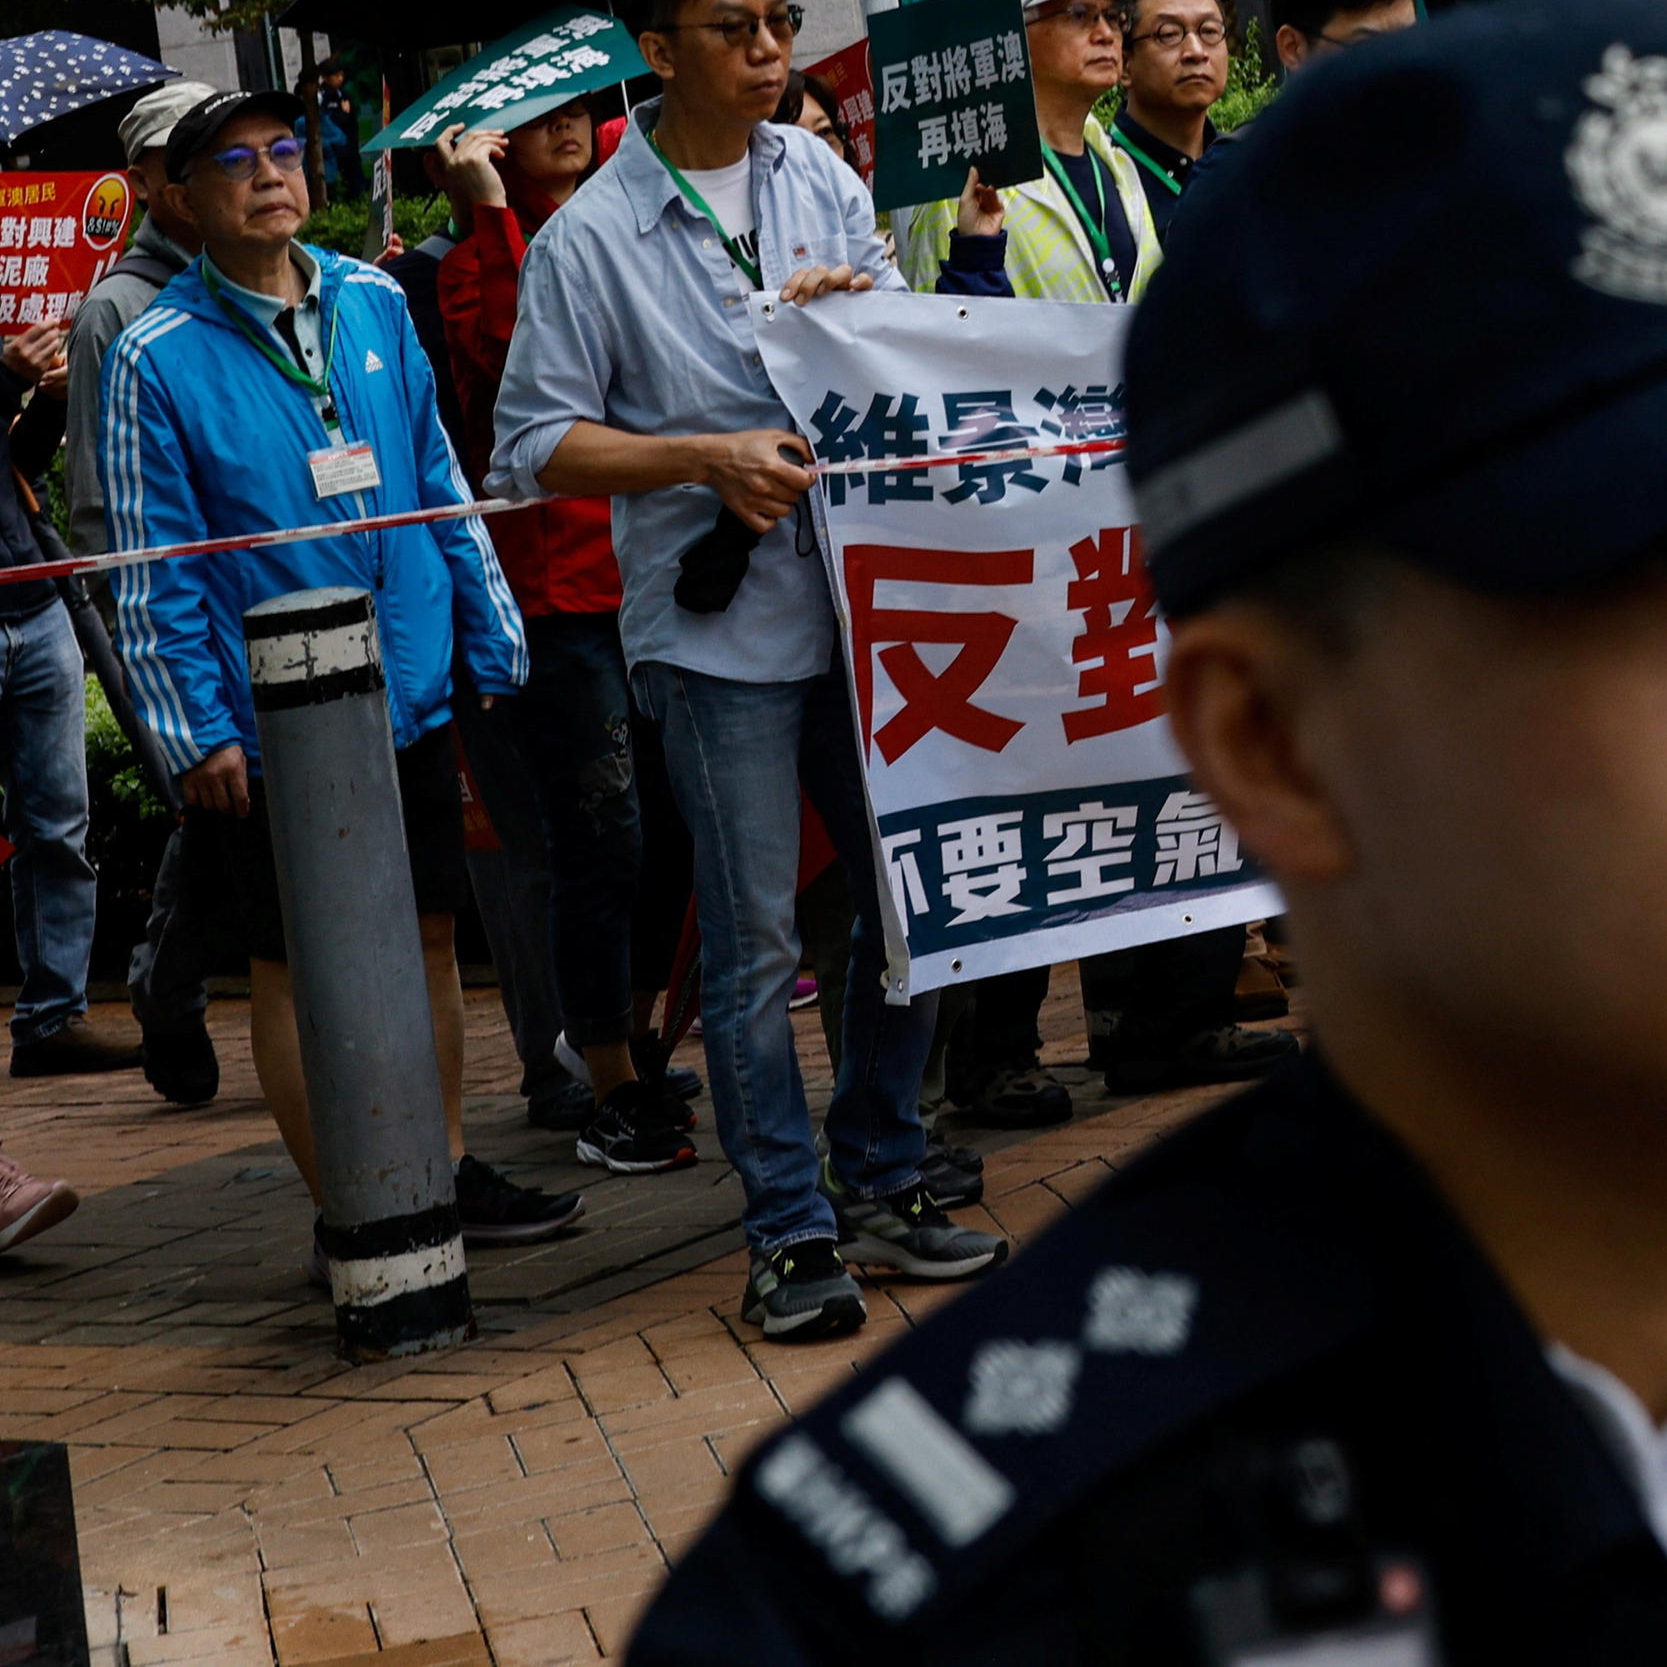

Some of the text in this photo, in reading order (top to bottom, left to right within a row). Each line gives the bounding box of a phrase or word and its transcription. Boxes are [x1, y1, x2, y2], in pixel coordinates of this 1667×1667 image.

[880, 30, 1027, 115] 反對將軍澳
[917, 101, 1009, 170] 再填海
